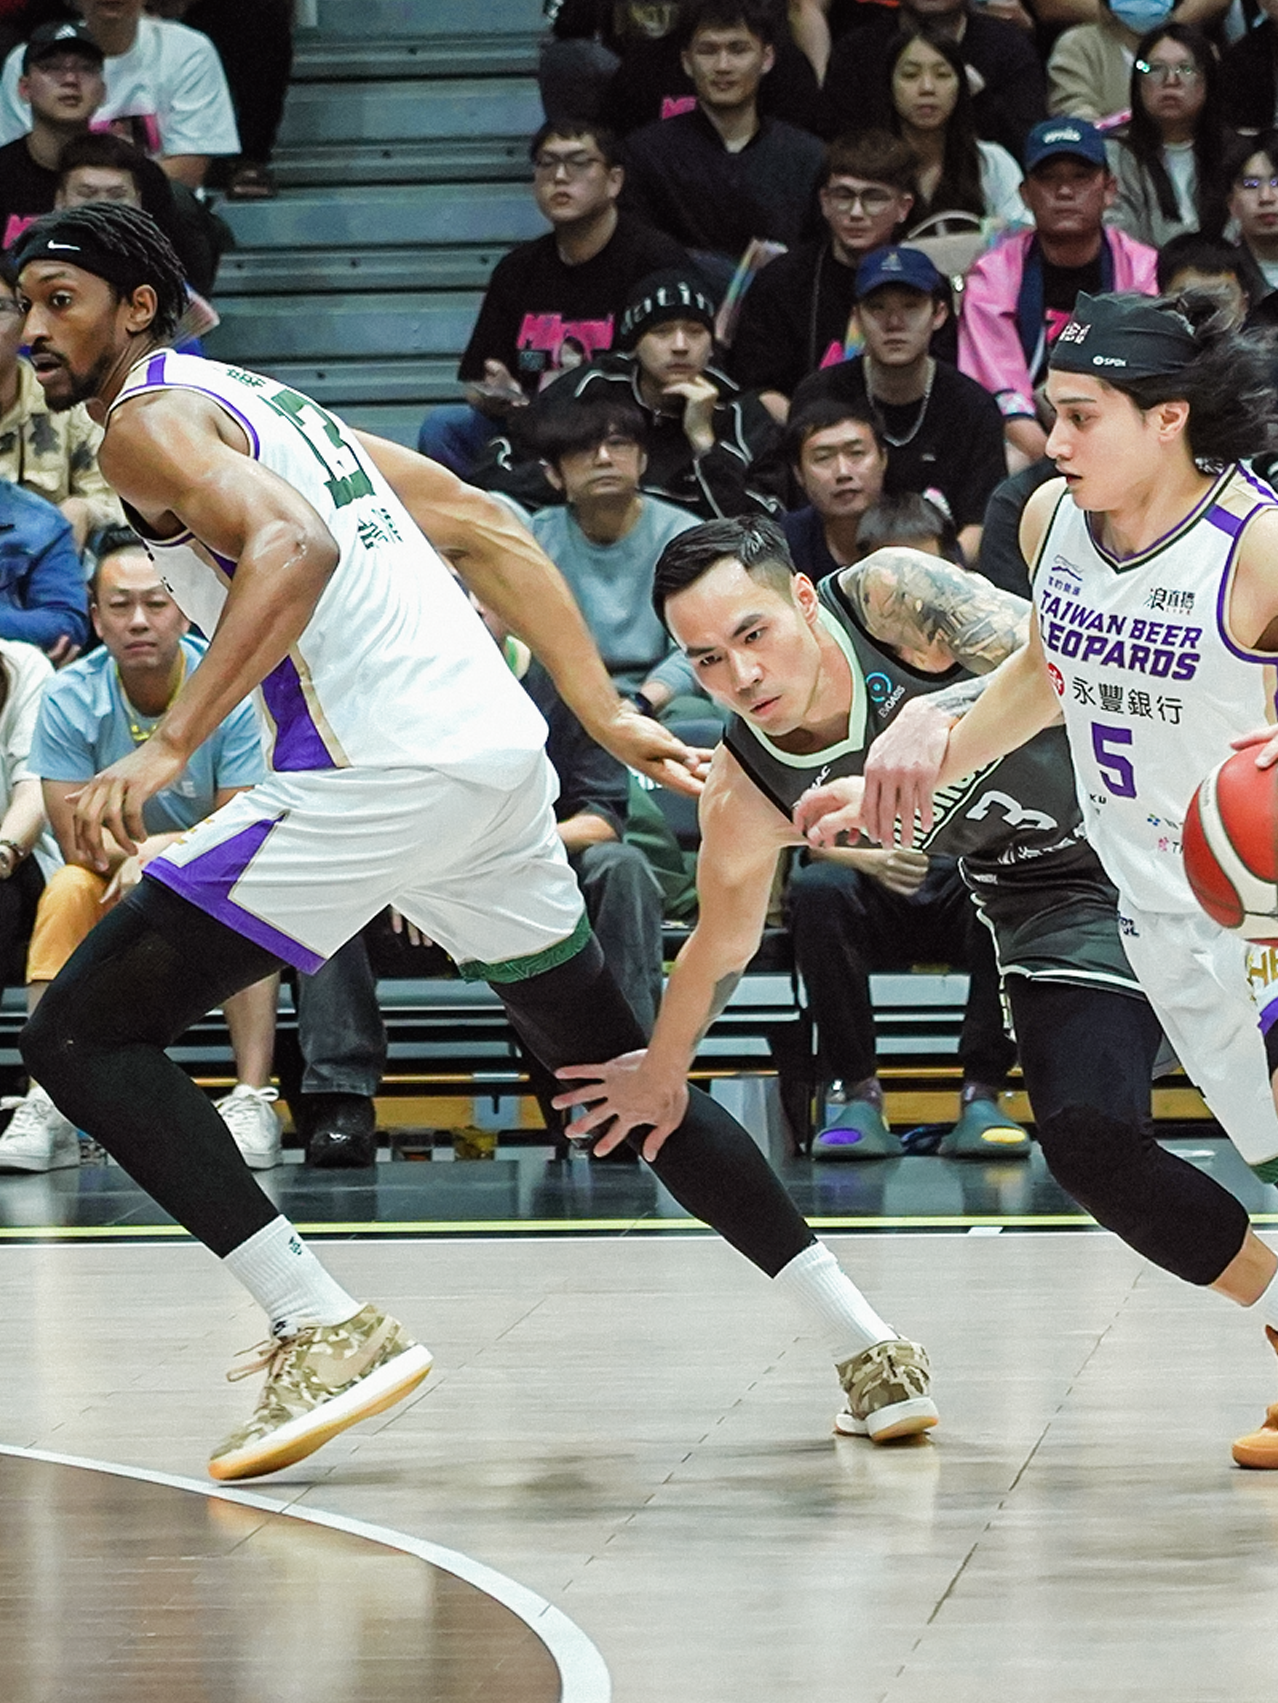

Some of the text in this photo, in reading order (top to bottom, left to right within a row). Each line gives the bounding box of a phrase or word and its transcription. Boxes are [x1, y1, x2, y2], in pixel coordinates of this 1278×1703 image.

[1040, 589, 1202, 649] TAIWAN BEER
[1040, 613, 1201, 681] LEOPARDS
[1072, 676, 1183, 725] 永豐銀行
[1091, 721, 1137, 799] 5
[965, 789, 1059, 831] 3
